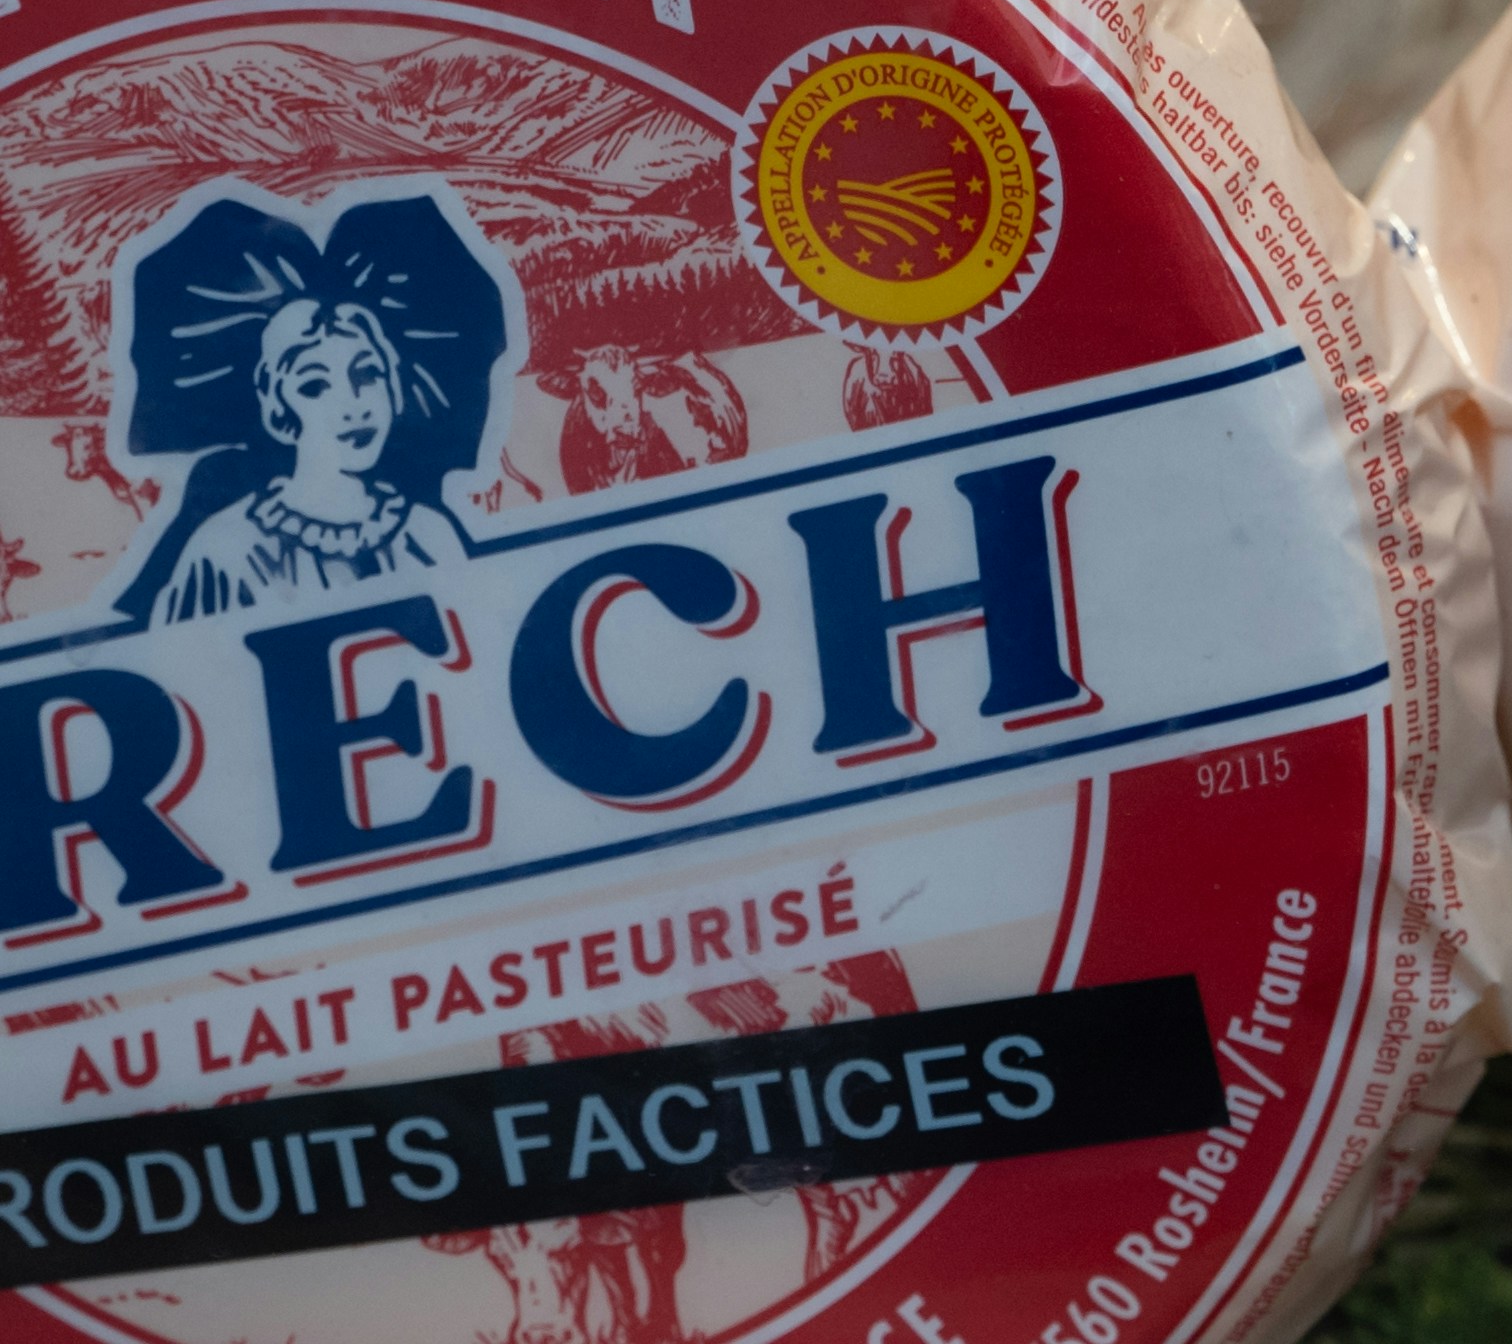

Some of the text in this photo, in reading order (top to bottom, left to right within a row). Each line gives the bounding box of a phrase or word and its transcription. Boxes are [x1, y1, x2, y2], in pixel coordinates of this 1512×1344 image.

[770, 63, 1029, 262] APPELLATION D'ORIGINE PROTÉGÉE
[1152, 89, 1228, 174] haltbar
[1254, 222, 1304, 291] siehe
[1298, 288, 1371, 435] Vorderseite
[1168, 69, 1260, 182] ouverture,
[1261, 179, 1339, 286] recouvrir
[1332, 292, 1362, 351] d'un
[1421, 597, 1440, 752] consommer
[1362, 455, 1396, 530] Nach
[1377, 534, 1406, 592] dem
[1395, 597, 1418, 691] Öffnen
[1198, 747, 1291, 799] 92115
[61, 861, 860, 1103] AU LAIT PASTEURISÉ
[493, 1034, 1056, 1188] FACTICES
